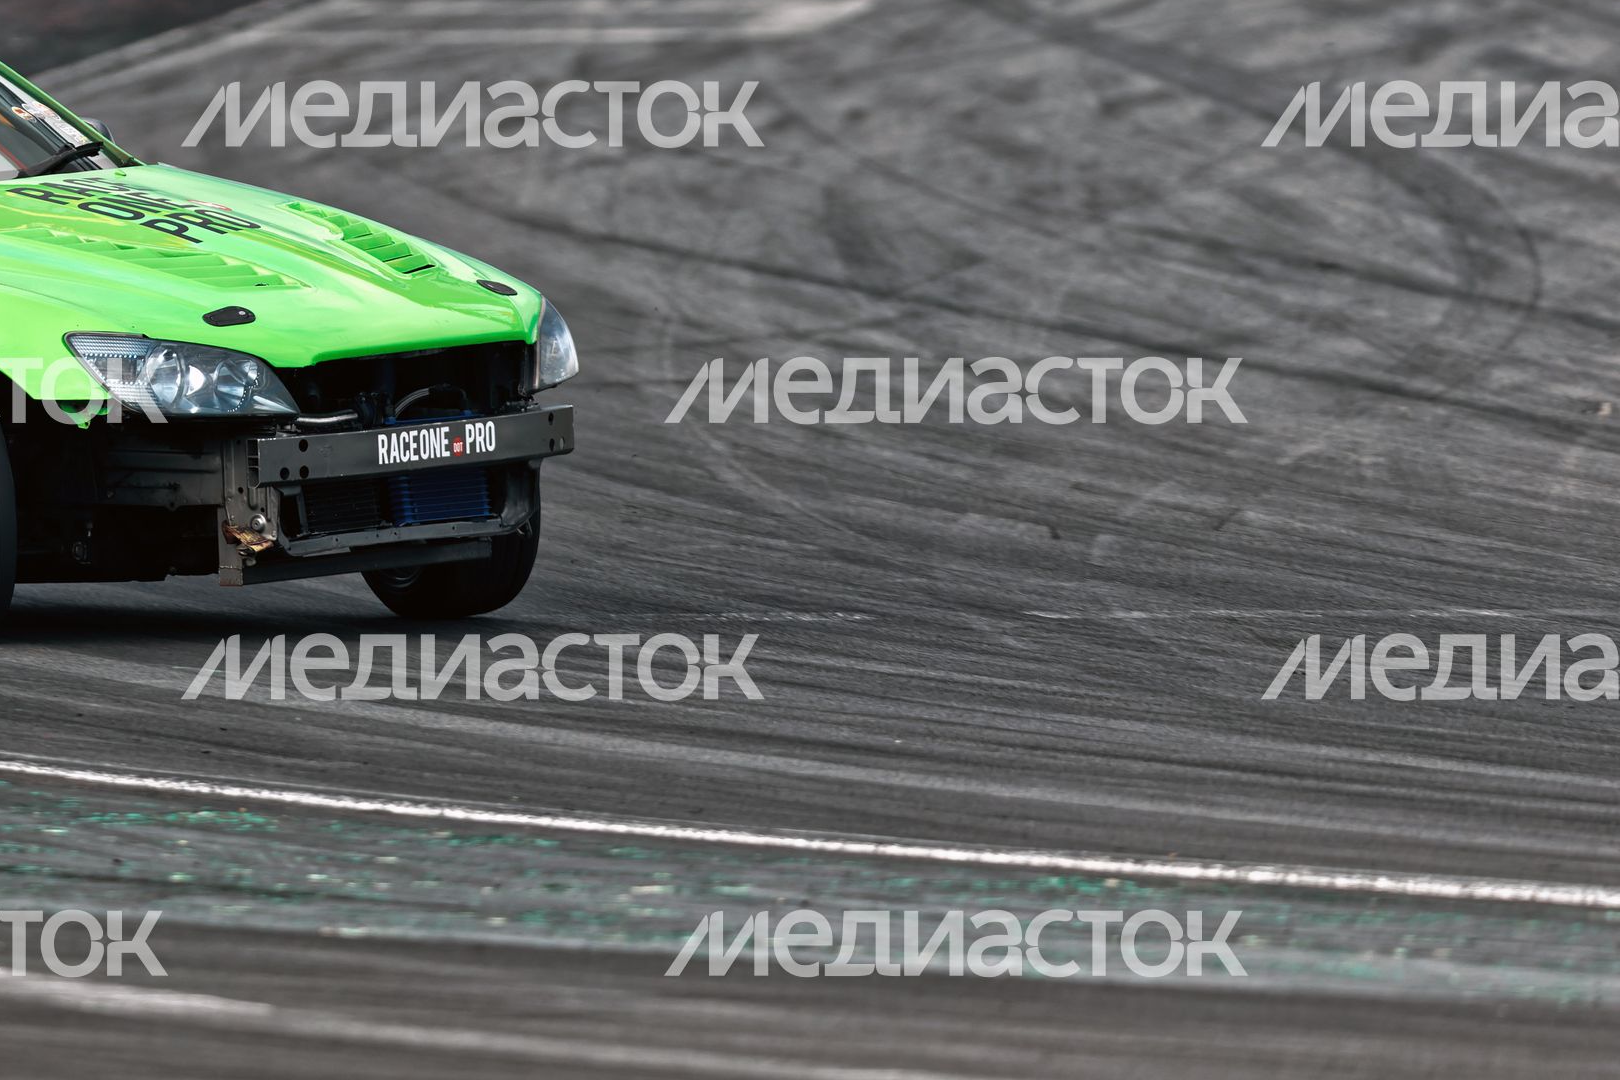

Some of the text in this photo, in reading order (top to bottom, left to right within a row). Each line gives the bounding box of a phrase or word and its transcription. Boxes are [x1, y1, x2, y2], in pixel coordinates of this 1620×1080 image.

[139, 209, 262, 244] PRO
[378, 426, 451, 465] RACEONE
[465, 420, 496, 454] PRO
